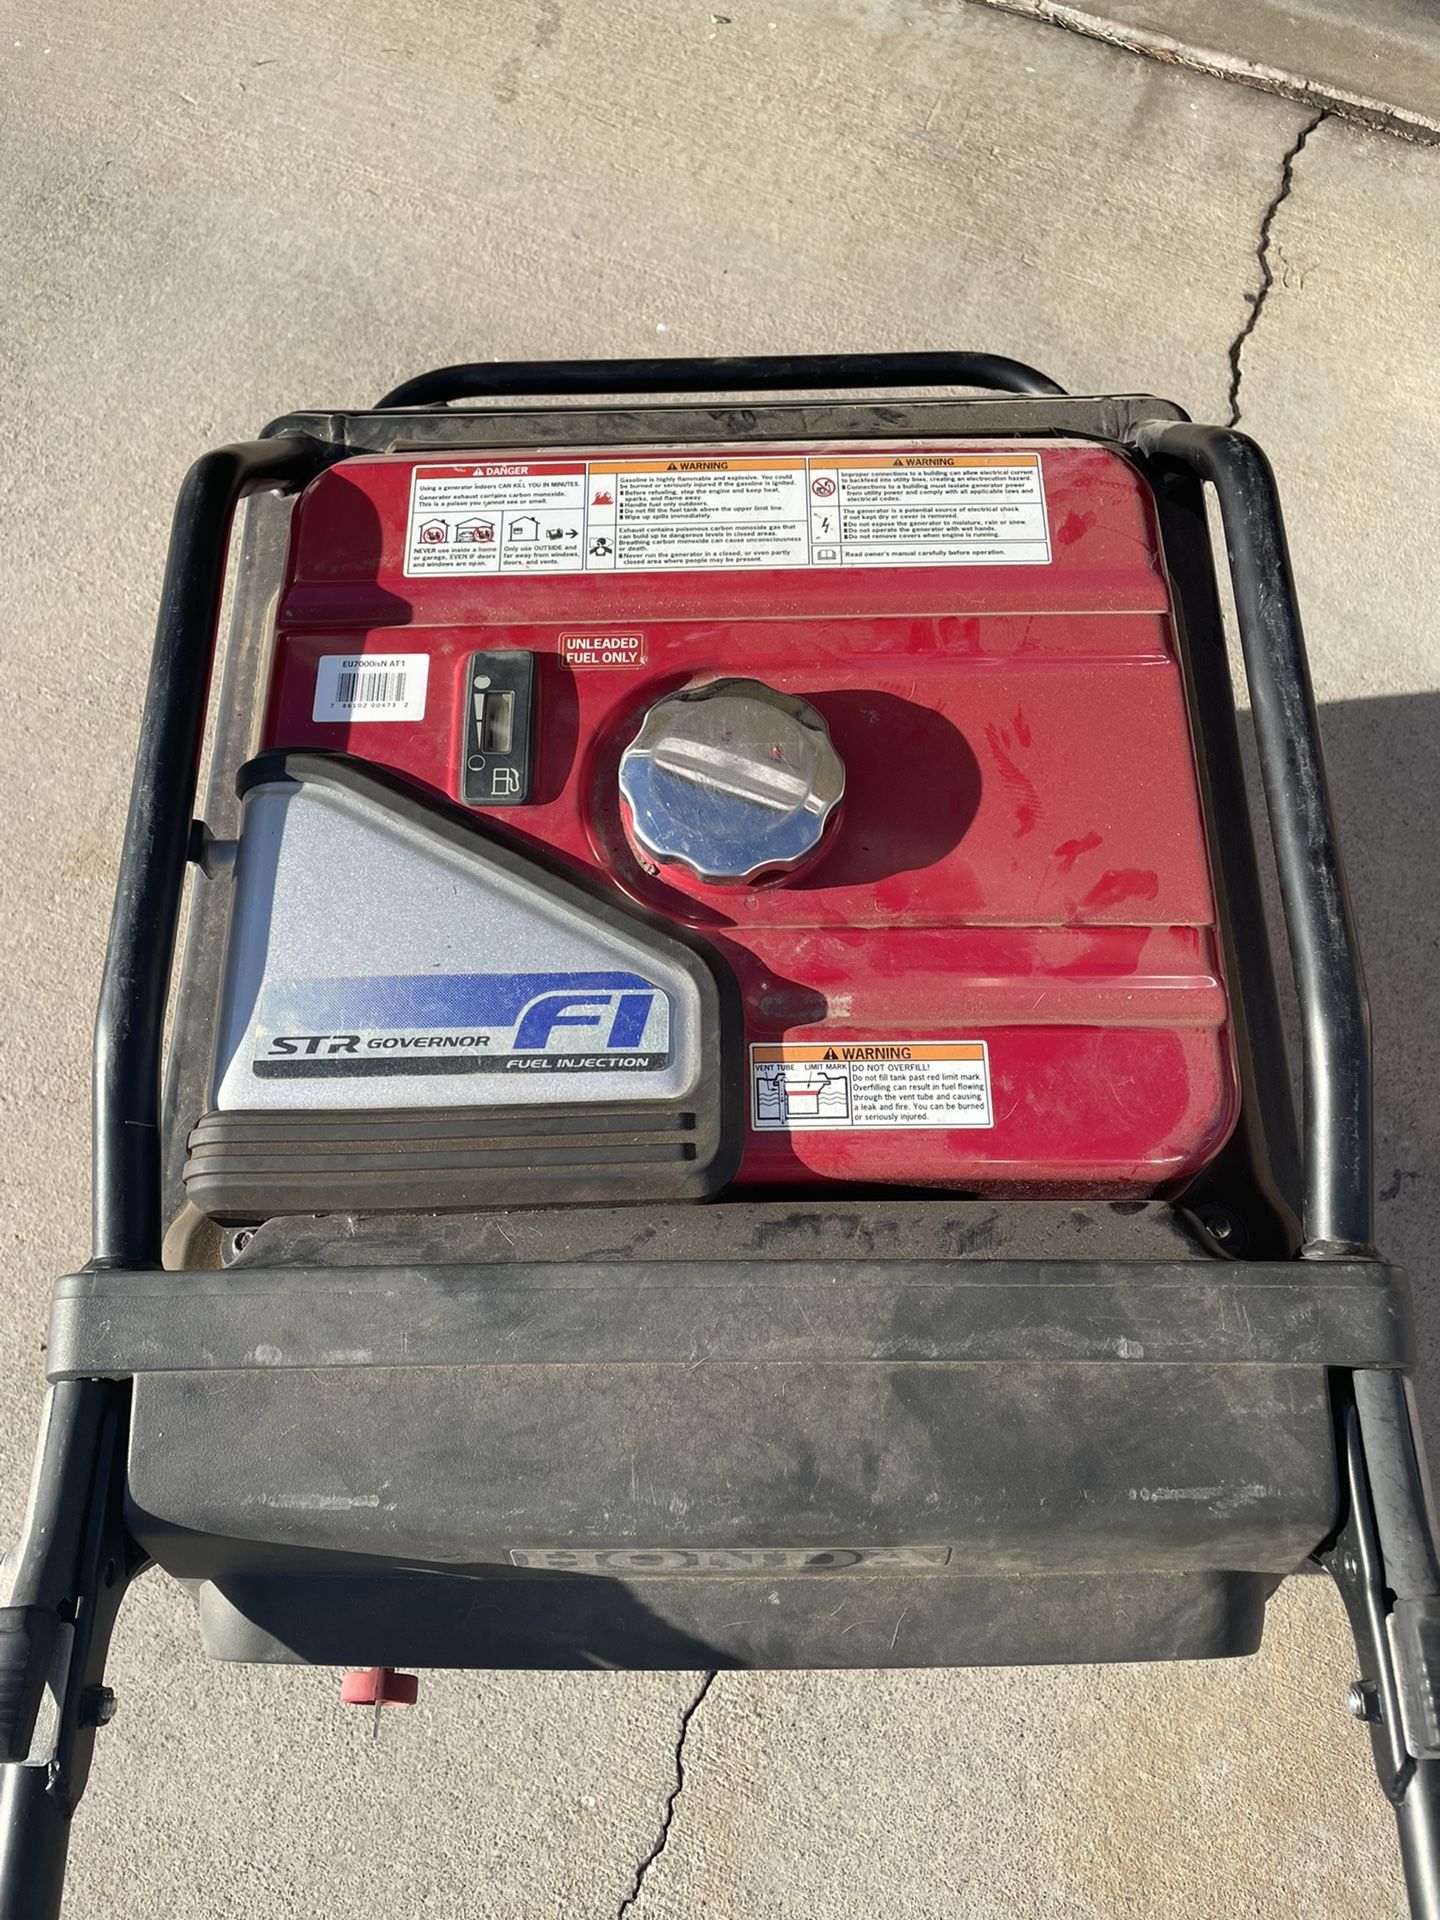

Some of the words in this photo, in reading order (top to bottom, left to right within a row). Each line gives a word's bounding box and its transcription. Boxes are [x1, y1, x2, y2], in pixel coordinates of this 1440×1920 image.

[566, 638, 638, 650] UNLEADED
[566, 652, 600, 663] FUEL
[602, 652, 638, 663] ONLY
[512, 994, 654, 1050] FI
[267, 1035, 361, 1056] STR
[366, 1035, 491, 1050] GOVERNOR
[842, 1048, 912, 1059] WARNING
[506, 1058, 553, 1070] FUEL
[556, 1057, 650, 1069] INJECTION
[853, 1084, 891, 1092] Overfilling
[526, 1549, 945, 1568] HONDA
